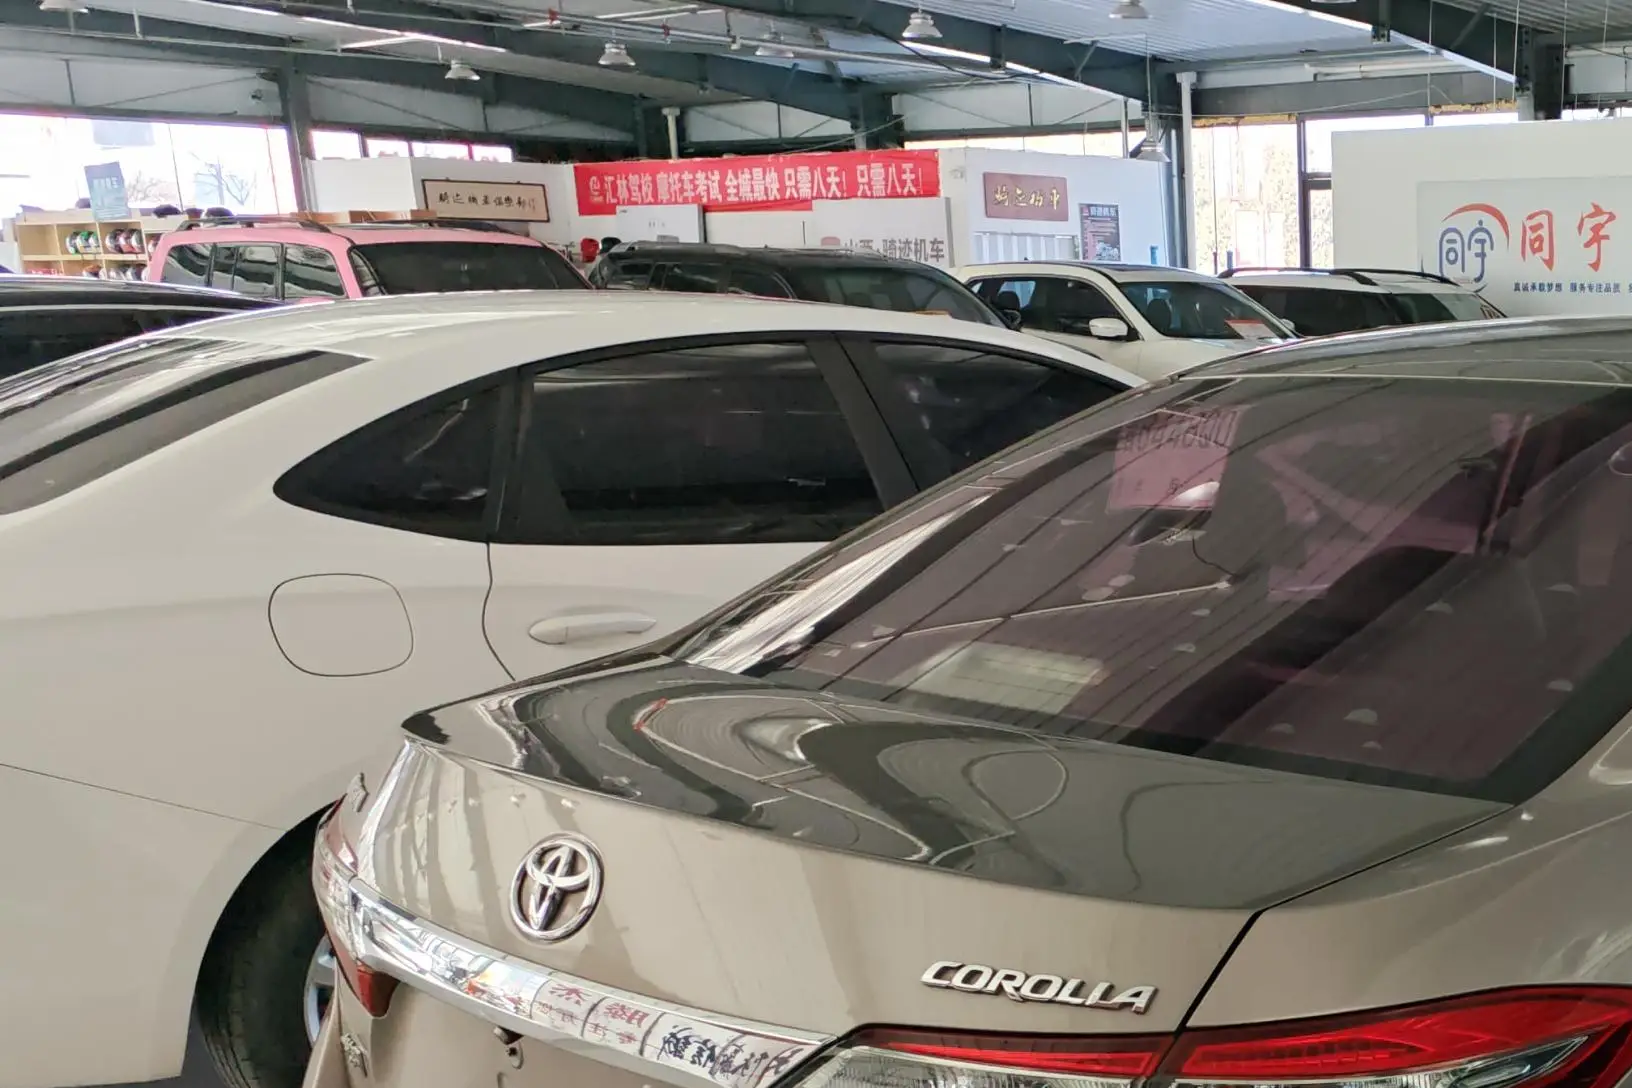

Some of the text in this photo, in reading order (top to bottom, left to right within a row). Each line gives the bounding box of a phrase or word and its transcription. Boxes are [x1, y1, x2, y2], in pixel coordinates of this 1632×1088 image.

[604, 171, 653, 204] 汇林驾校
[656, 169, 722, 203] 摩托车考试
[725, 166, 780, 201] 全城最快
[784, 165, 847, 198] 只需八天！
[857, 162, 923, 197] 只需八天！
[920, 961, 1159, 1015] COROLLA
